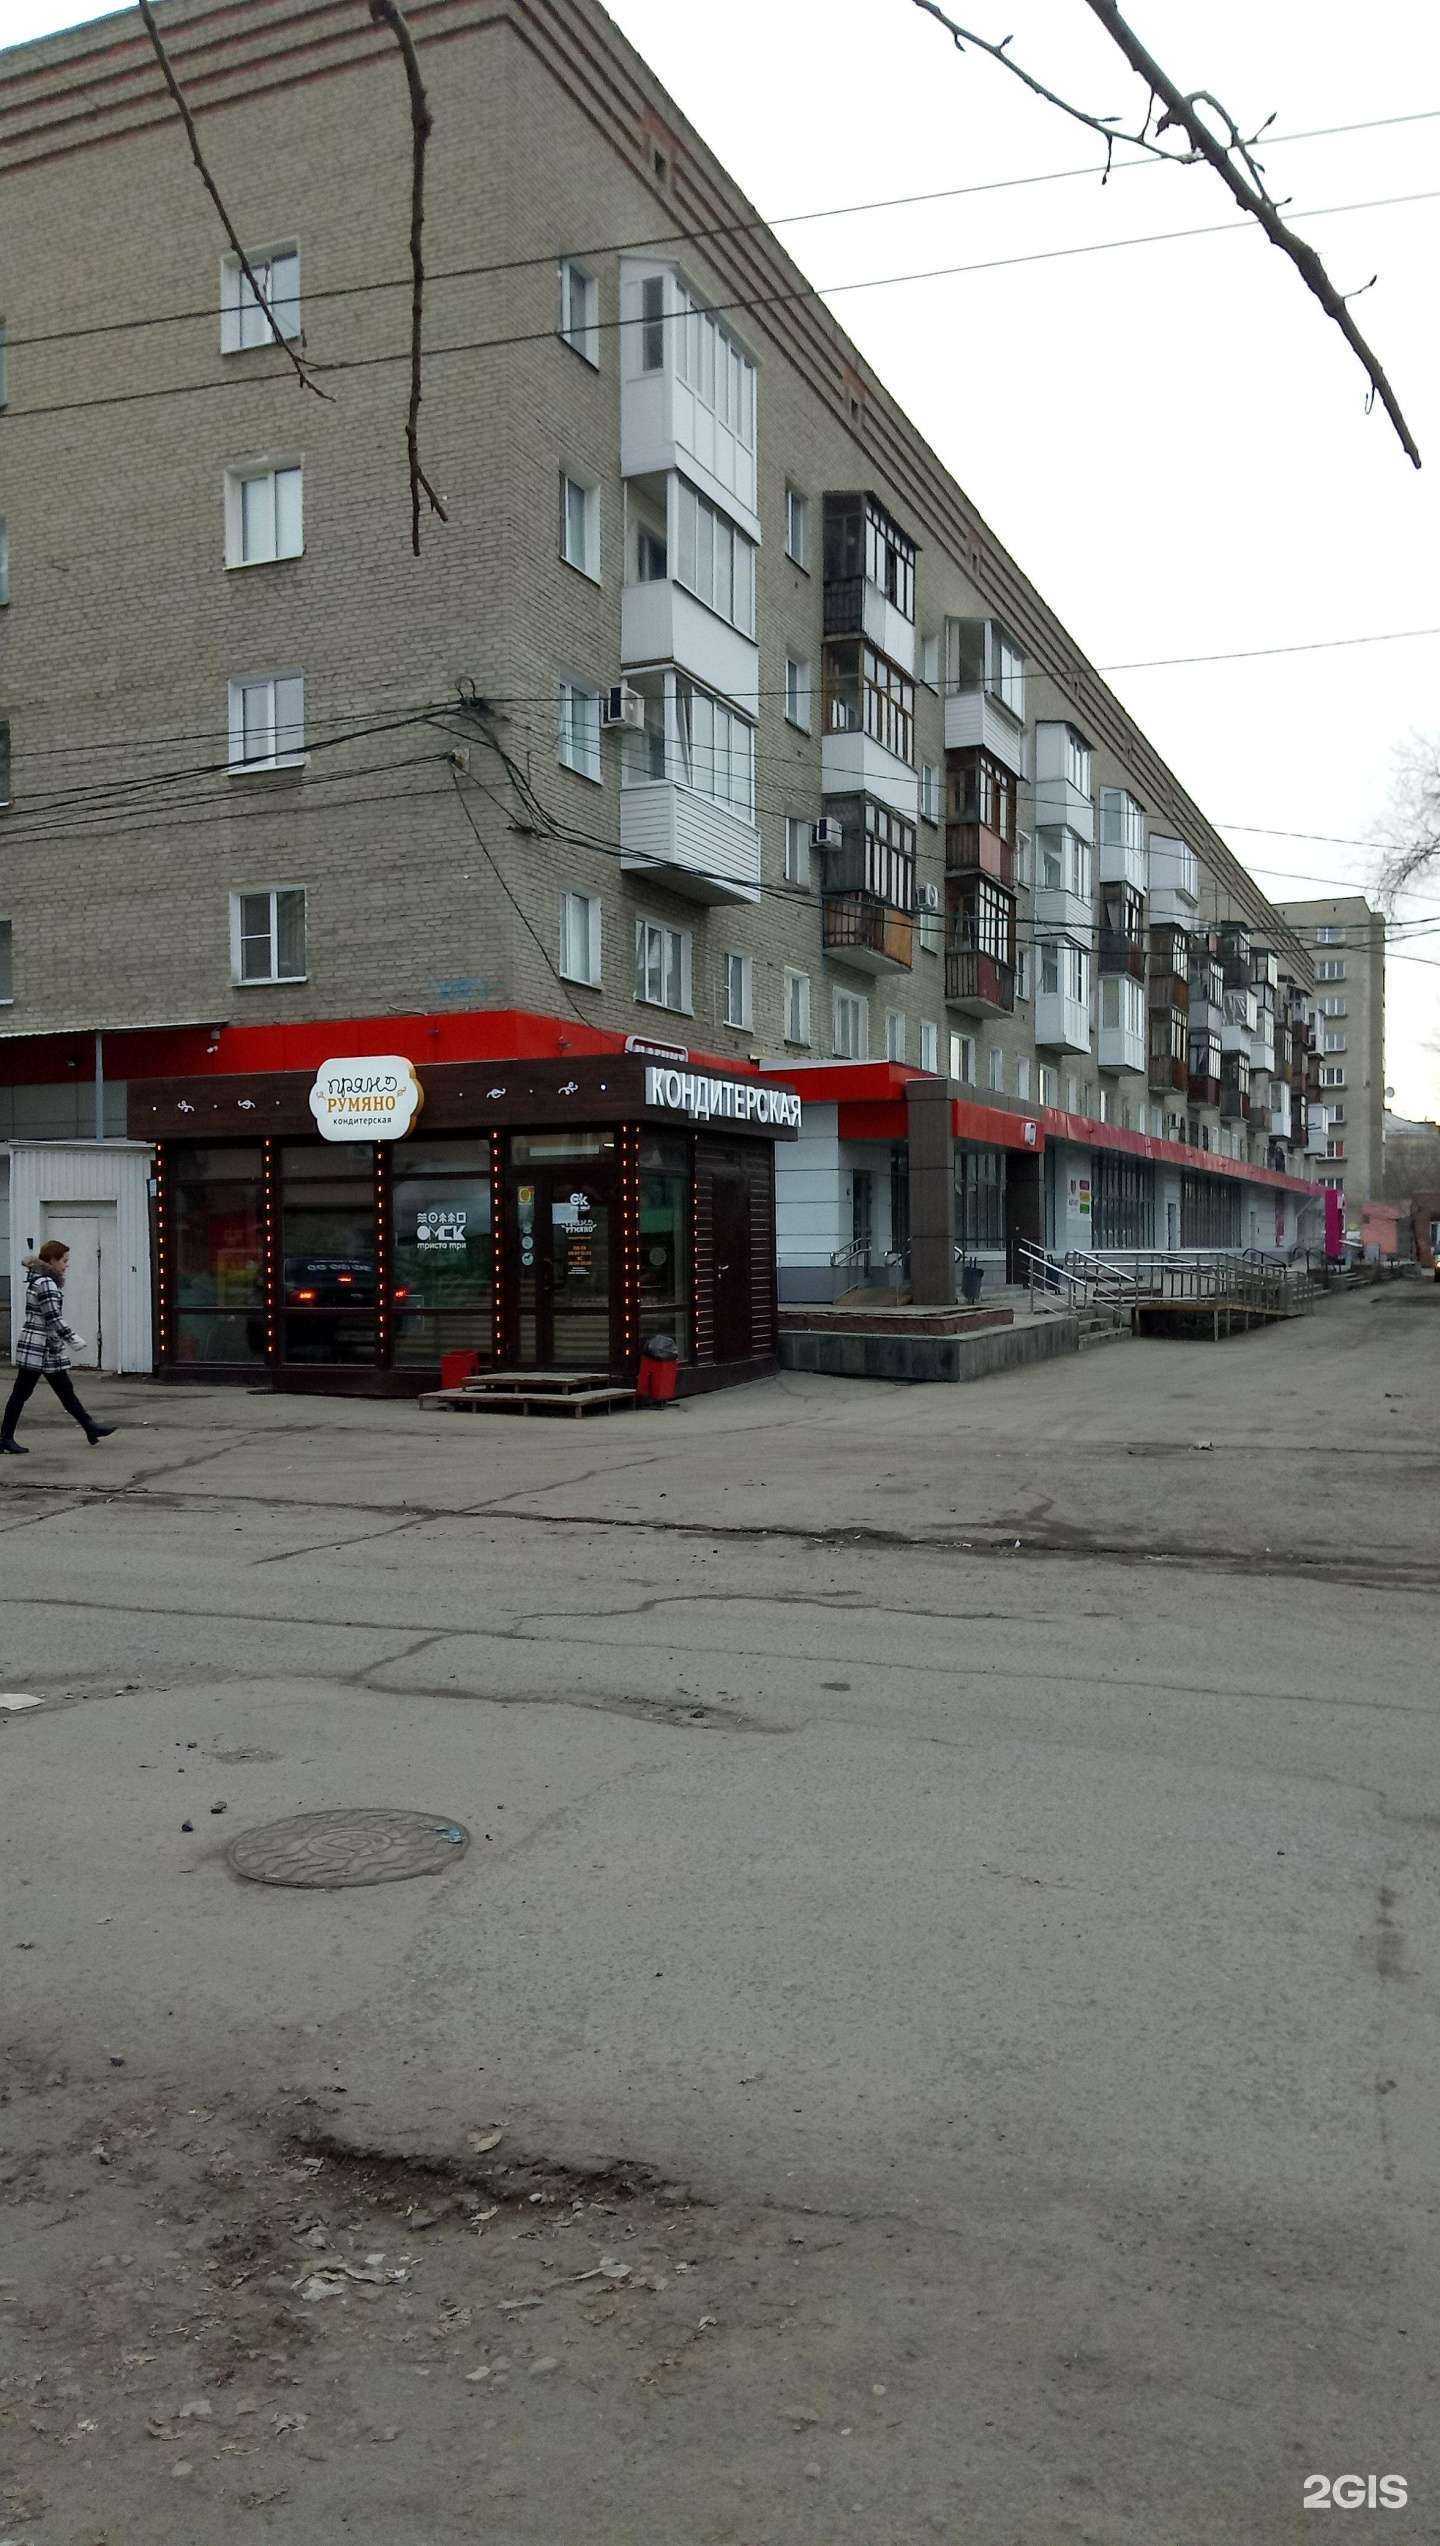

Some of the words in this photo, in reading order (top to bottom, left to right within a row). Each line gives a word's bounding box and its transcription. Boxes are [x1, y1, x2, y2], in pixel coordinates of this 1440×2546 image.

[327, 1095, 396, 1113] РУМЯНО
[645, 1066, 802, 1128] КОНДИТЕРСКАЯ
[333, 1117, 392, 1126] кондитерская
[416, 1225, 466, 1241] ОМСК
[449, 1242, 467, 1251] три
